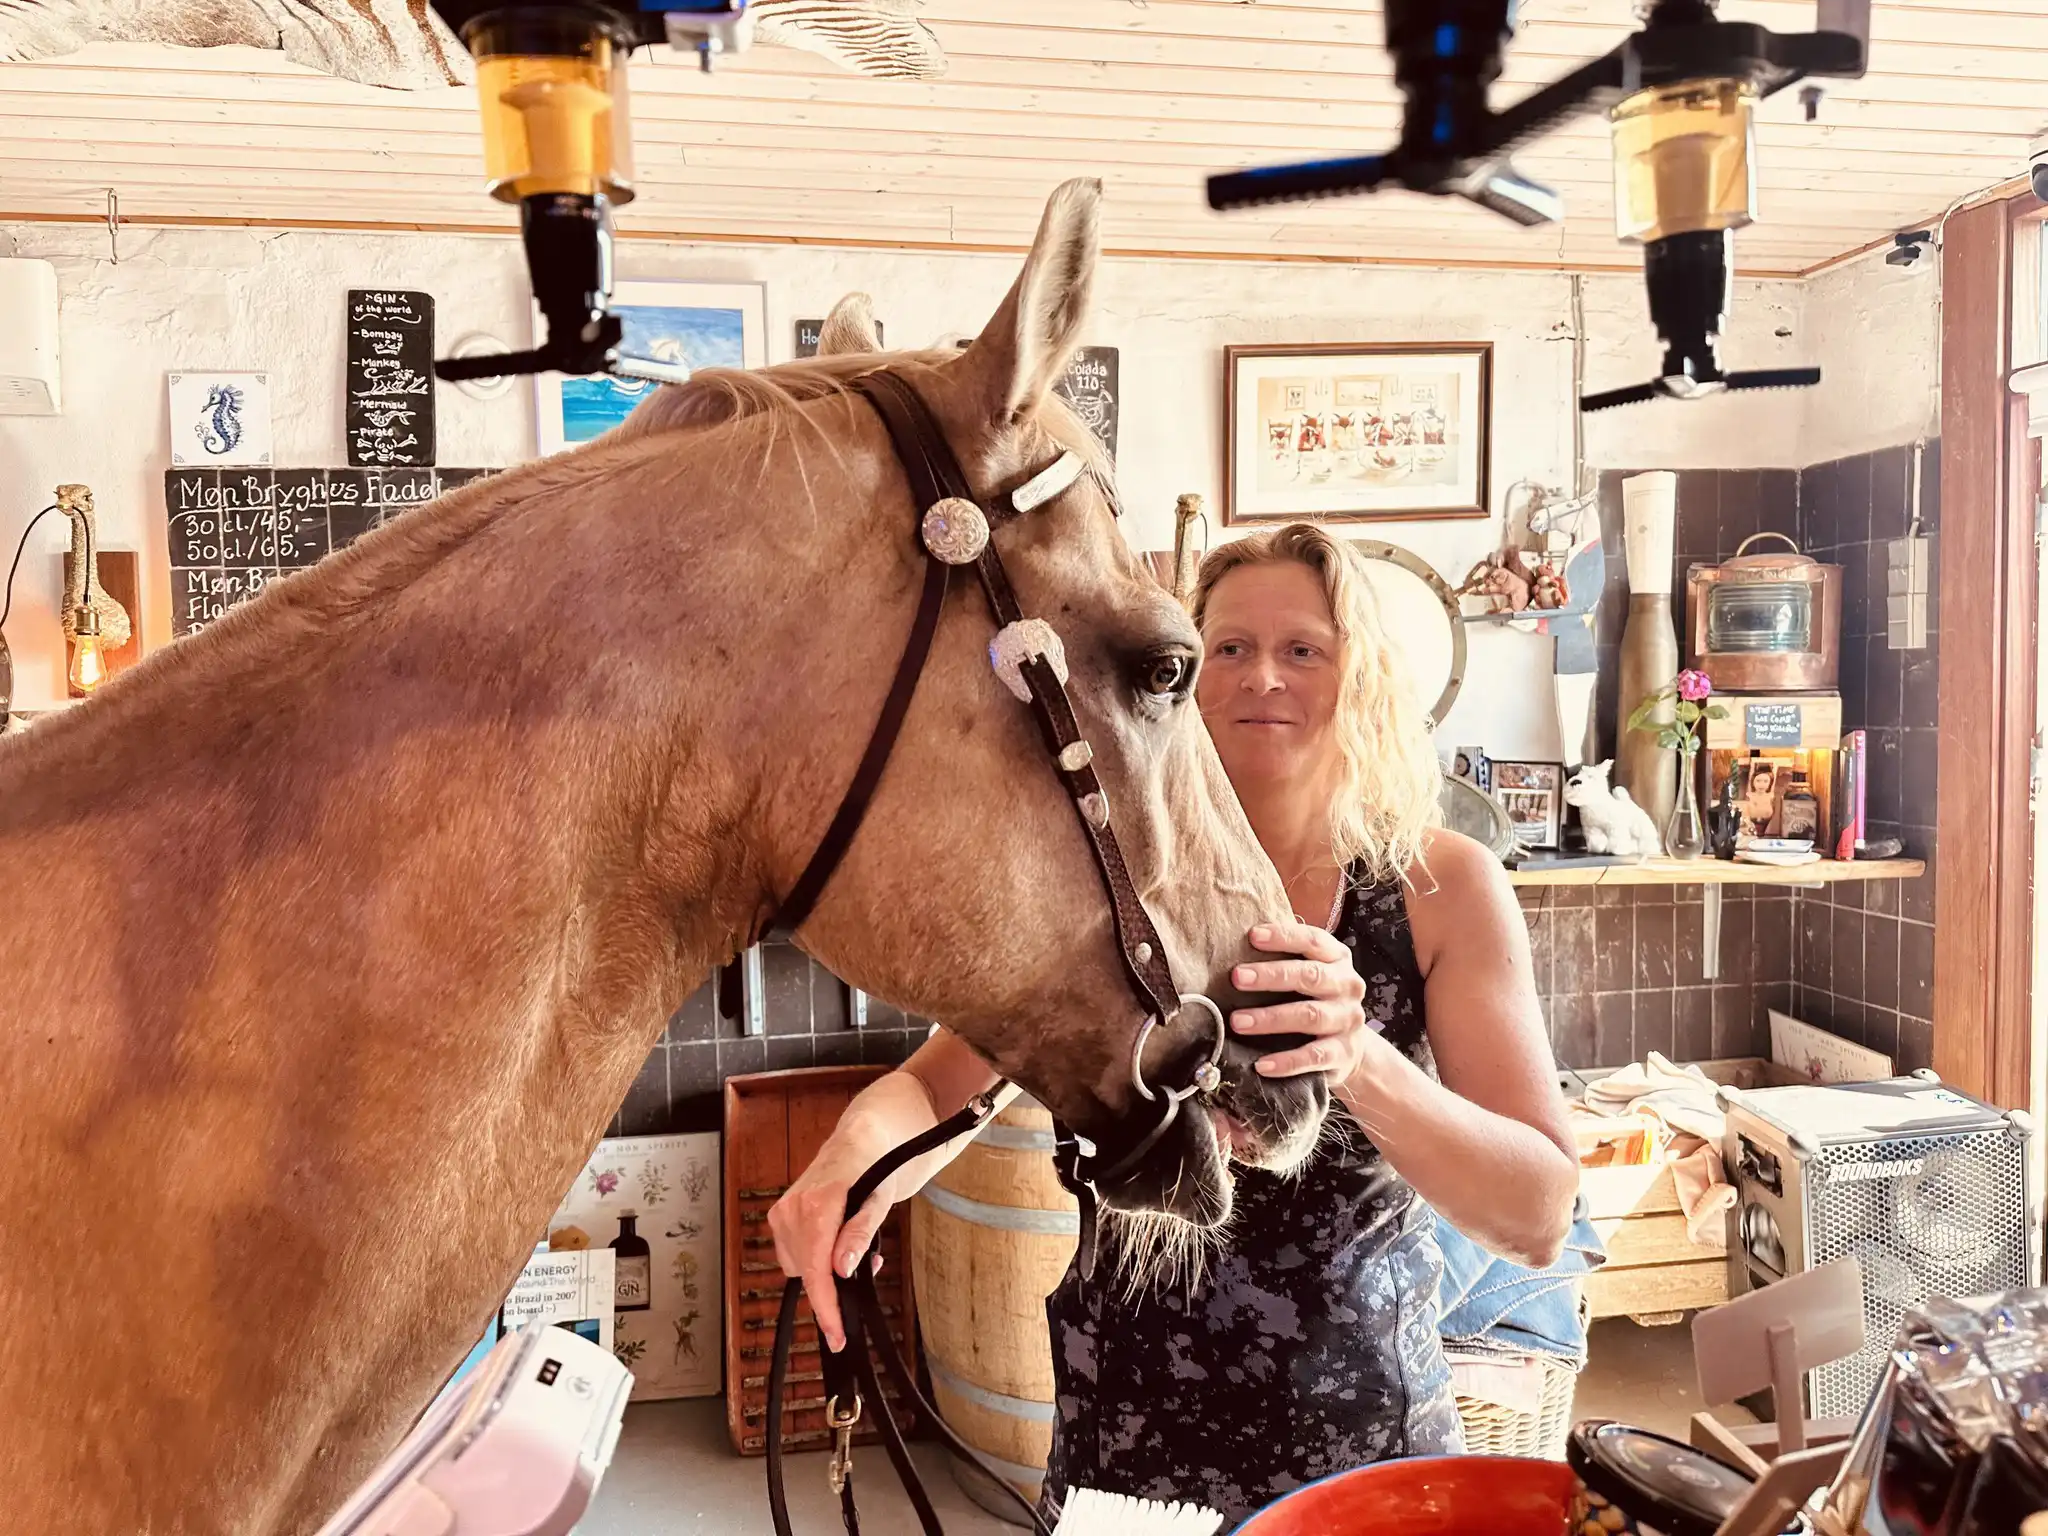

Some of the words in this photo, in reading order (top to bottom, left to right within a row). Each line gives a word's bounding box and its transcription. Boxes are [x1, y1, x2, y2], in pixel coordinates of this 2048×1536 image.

[374, 293, 396, 304] GIN
[355, 304, 363, 312] of
[366, 305, 381, 313] the
[385, 306, 412, 314] world
[361, 328, 403, 341] Bombay
[361, 358, 401, 369] Monkey
[360, 399, 407, 409] Mermaid
[360, 427, 394, 438] Pirate
[180, 476, 241, 509] Møn
[241, 475, 359, 511] Bryghus
[184, 514, 215, 537] 30
[186, 539, 218, 561] 50
[187, 570, 243, 596] Møn
[1828, 1158, 1924, 1182] SOUNDBOKS
[534, 1265, 578, 1277] ENERGY
[515, 1291, 542, 1304] Brazil
[543, 1292, 553, 1302] in
[555, 1290, 577, 1301] 2007
[517, 1303, 544, 1316] board
